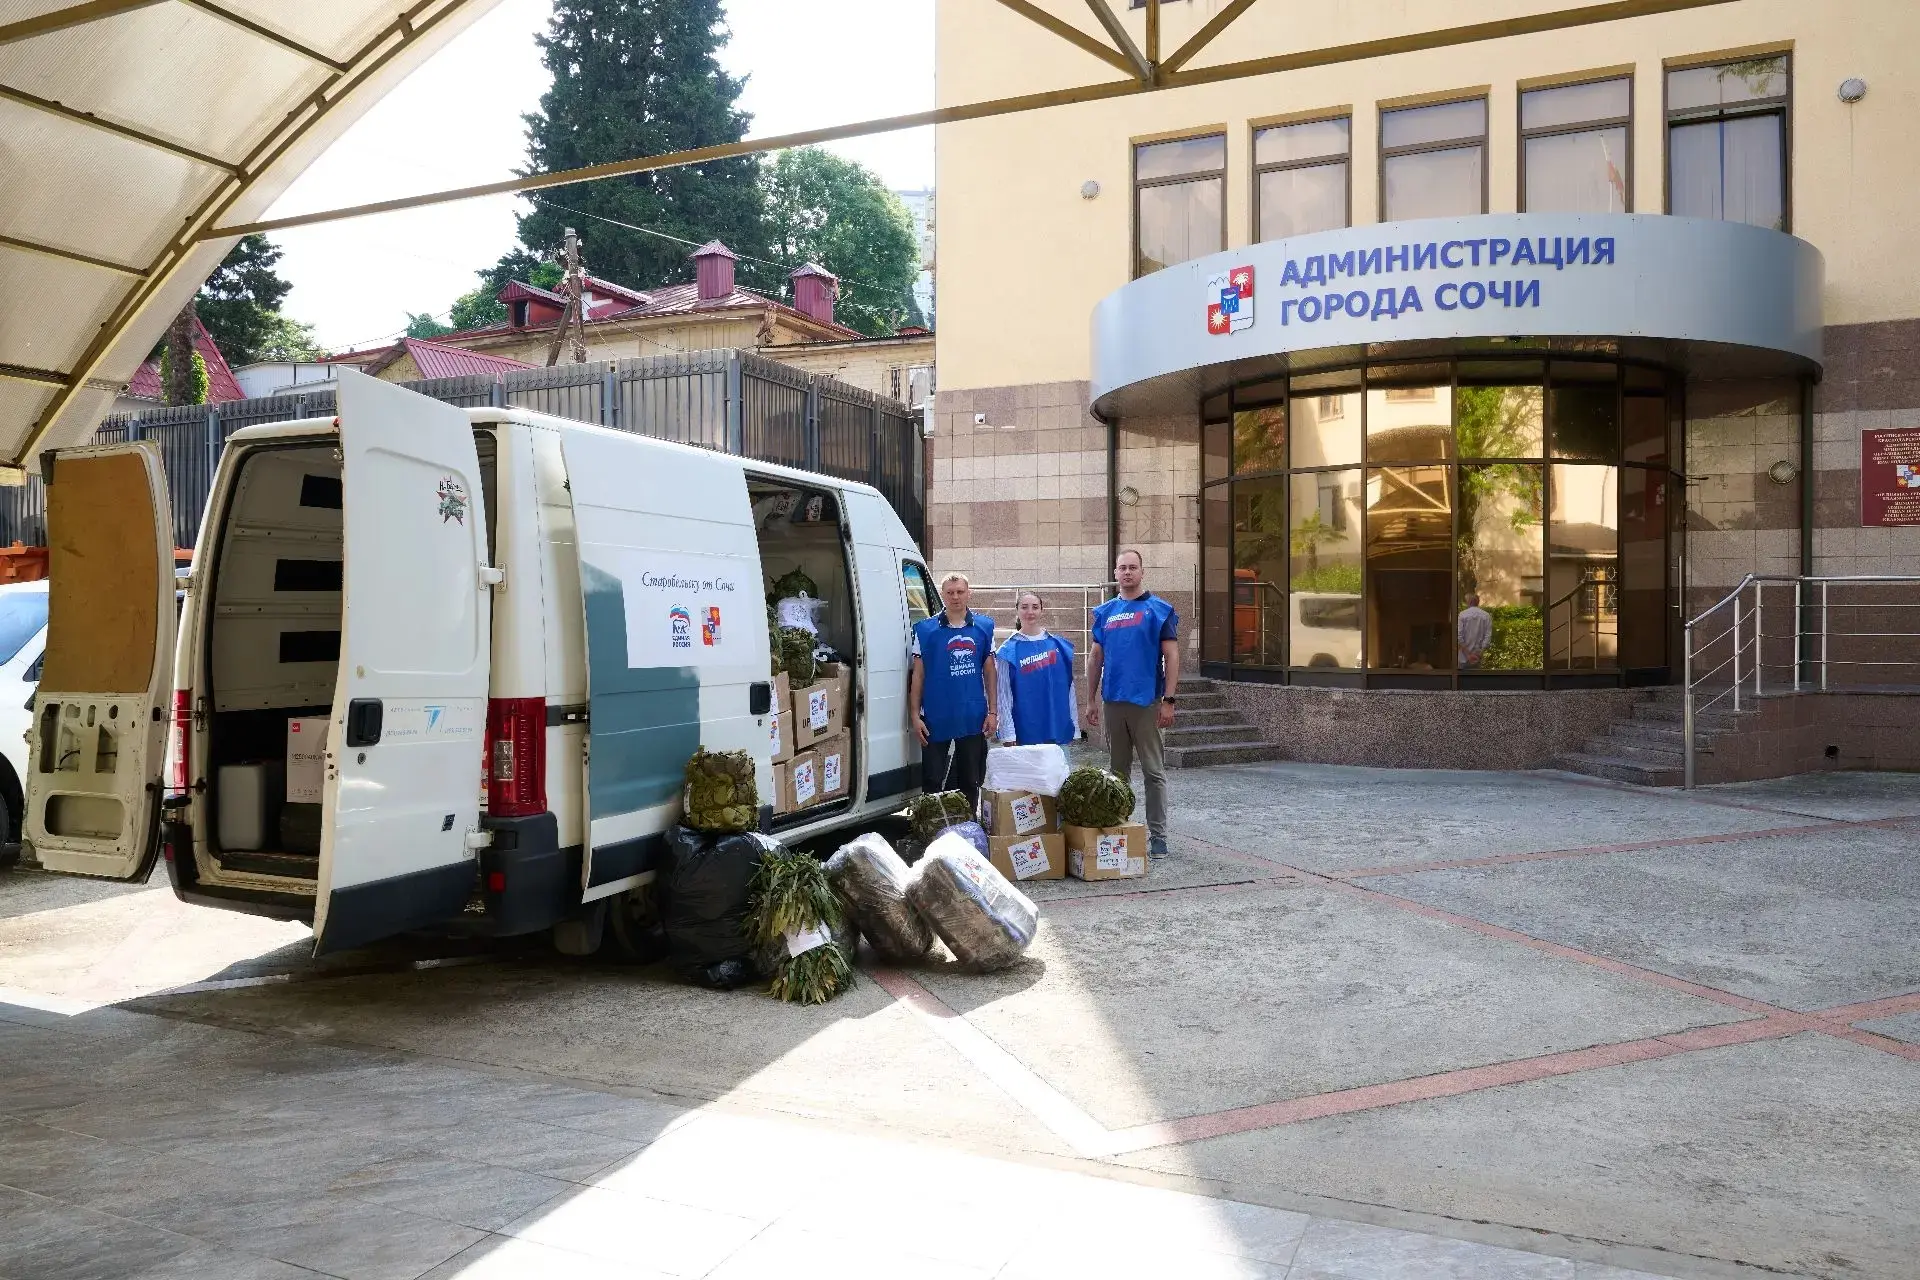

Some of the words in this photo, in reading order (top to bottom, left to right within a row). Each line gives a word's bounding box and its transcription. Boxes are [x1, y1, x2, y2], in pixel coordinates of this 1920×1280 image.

[1280, 237, 1617, 287] АДМИНИСТРАЦИЯ
[1281, 282, 1424, 326] ГОРОДА
[1434, 280, 1541, 312] СОЧИ
